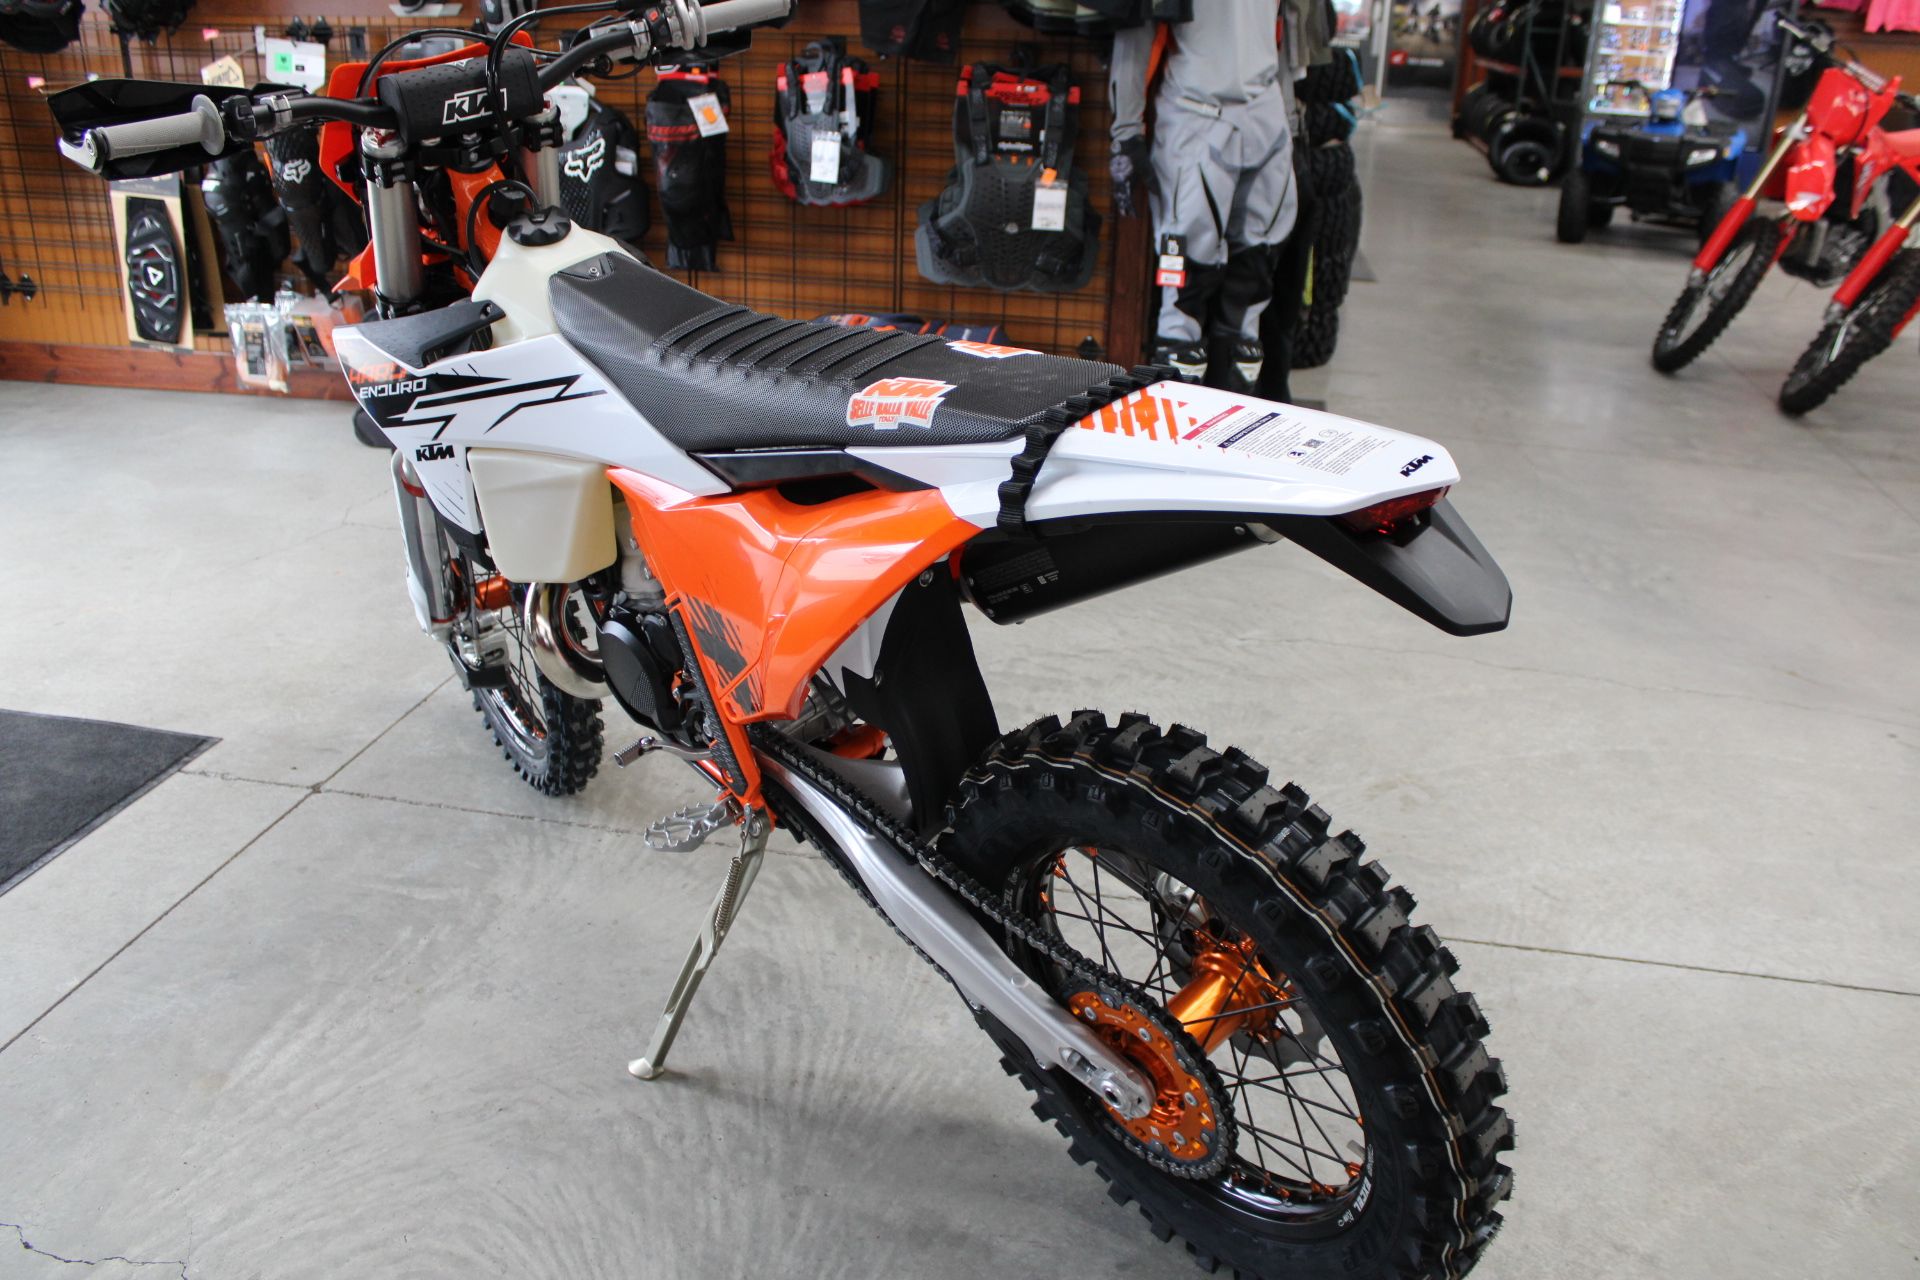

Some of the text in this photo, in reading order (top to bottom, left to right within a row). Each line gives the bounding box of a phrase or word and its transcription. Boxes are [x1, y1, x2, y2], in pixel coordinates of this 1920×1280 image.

[359, 377, 428, 399] ENDURO
[863, 379, 946, 397] KTM
[850, 398, 876, 420] SELLE
[903, 399, 938, 420] VALLE
[1229, 420, 1260, 442] COMPETITION
[415, 442, 456, 462] KTM
[1399, 455, 1434, 478] KTM
